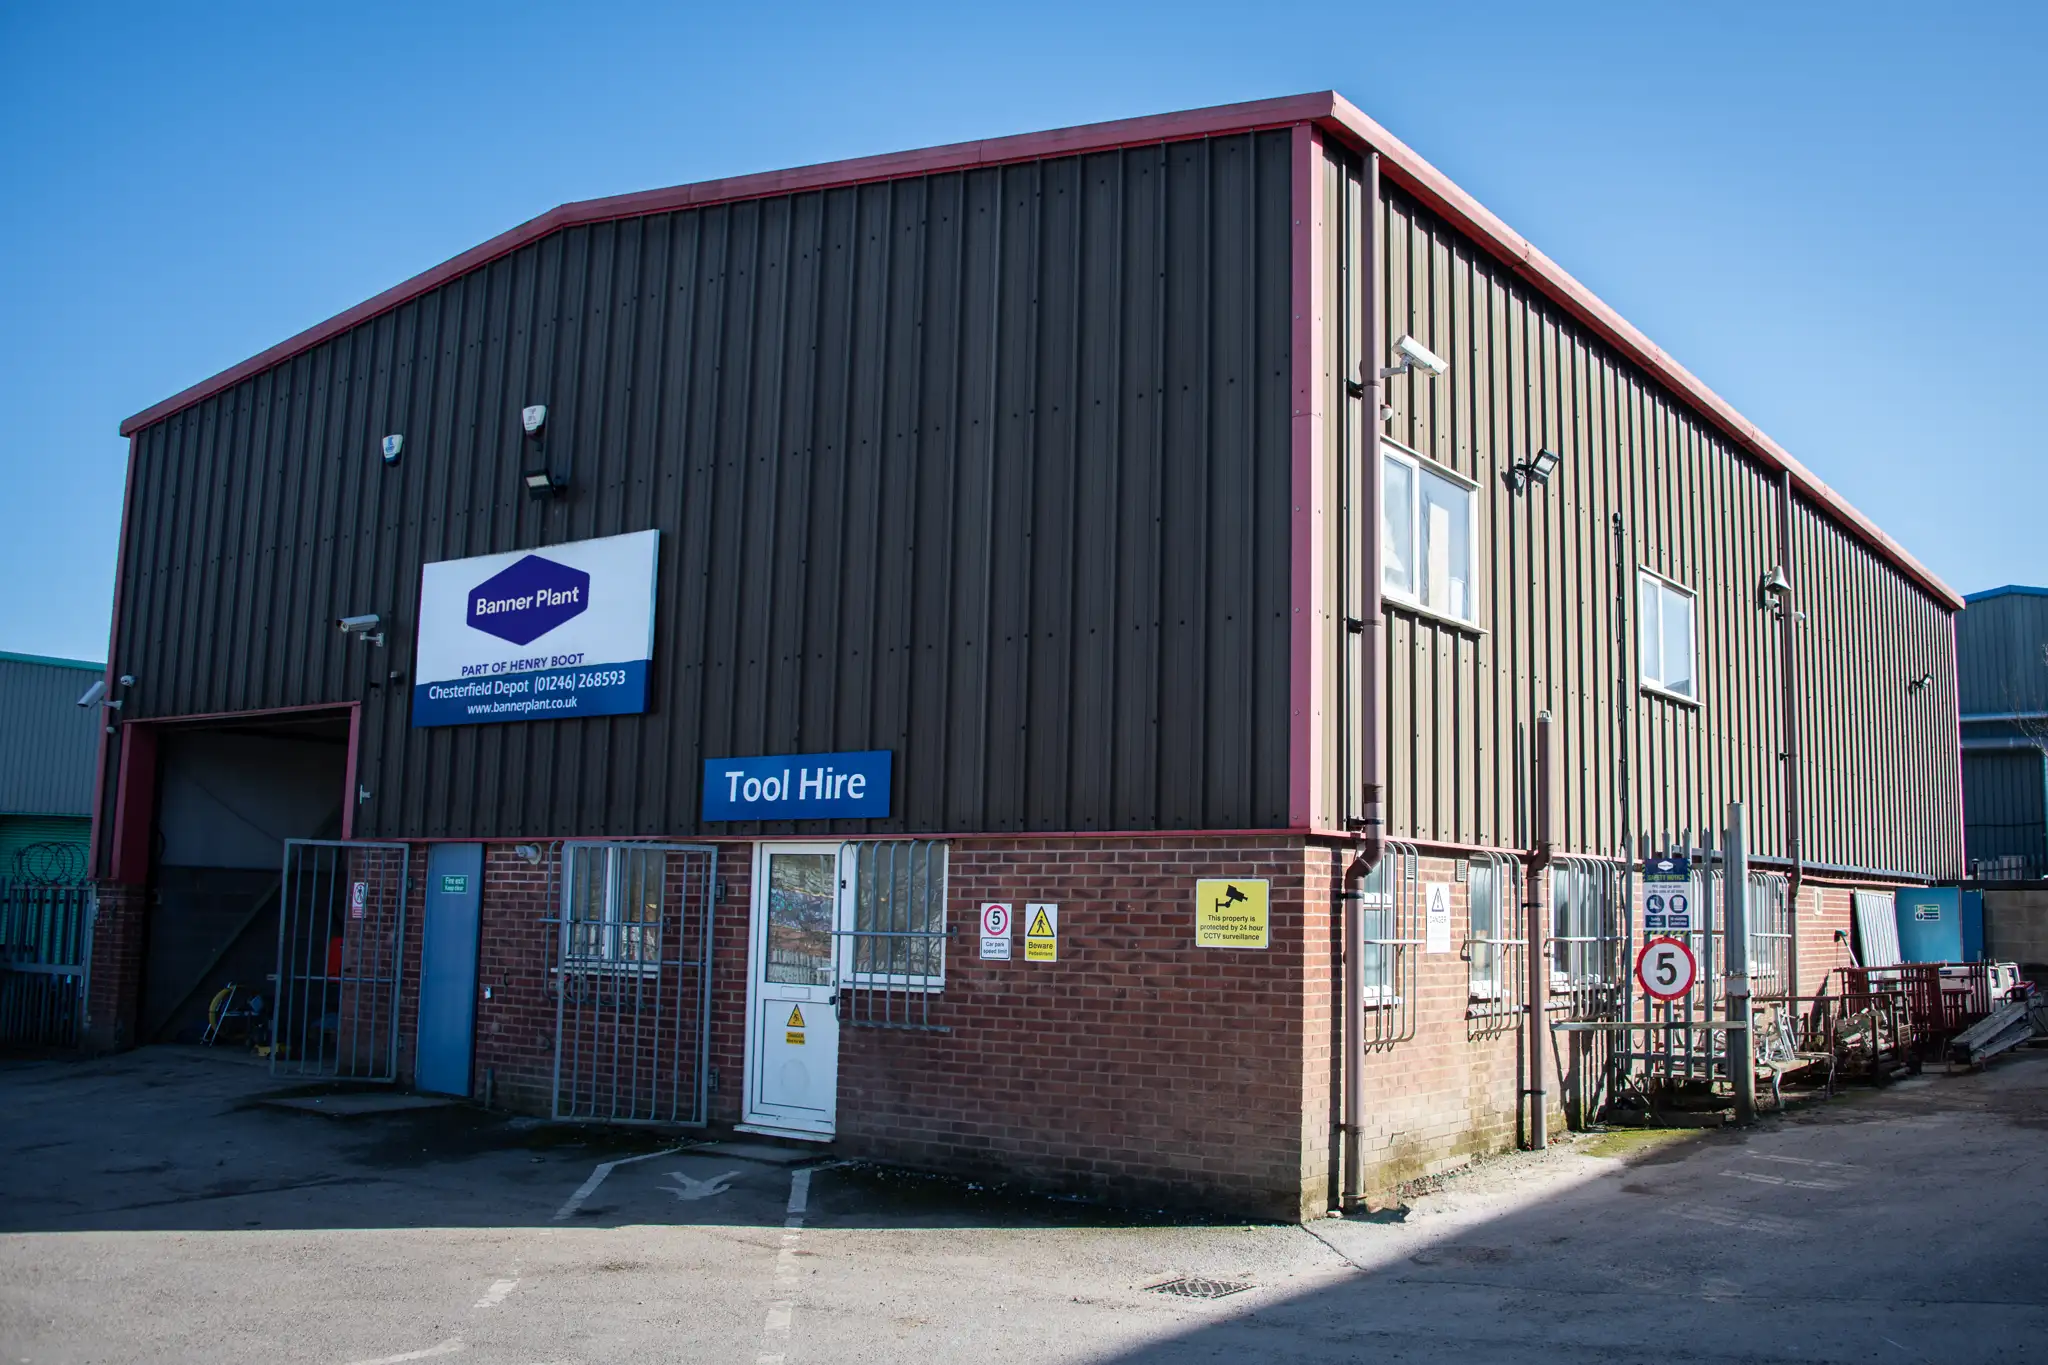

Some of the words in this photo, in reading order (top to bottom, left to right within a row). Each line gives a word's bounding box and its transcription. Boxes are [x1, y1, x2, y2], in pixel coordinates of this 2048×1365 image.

[476, 595, 533, 616] Banner
[536, 586, 580, 607] Plant
[461, 664, 489, 677] PART
[492, 661, 507, 673] OF
[510, 657, 548, 671] HENRY
[551, 653, 584, 667] BOOT
[429, 682, 492, 699] Chesterfield
[494, 680, 529, 697] Depot
[534, 673, 576, 694] (01246)
[578, 670, 626, 689] 268593
[467, 697, 577, 714] www.bannerplant.co.uk
[725, 769, 790, 802] Tool
[799, 767, 867, 800] Hire
[992, 911, 1001, 925] 5
[1230, 924, 1238, 932] by
[1028, 941, 1054, 949] Beware
[1222, 933, 1260, 941] surveillance
[1656, 952, 1677, 985] 5
